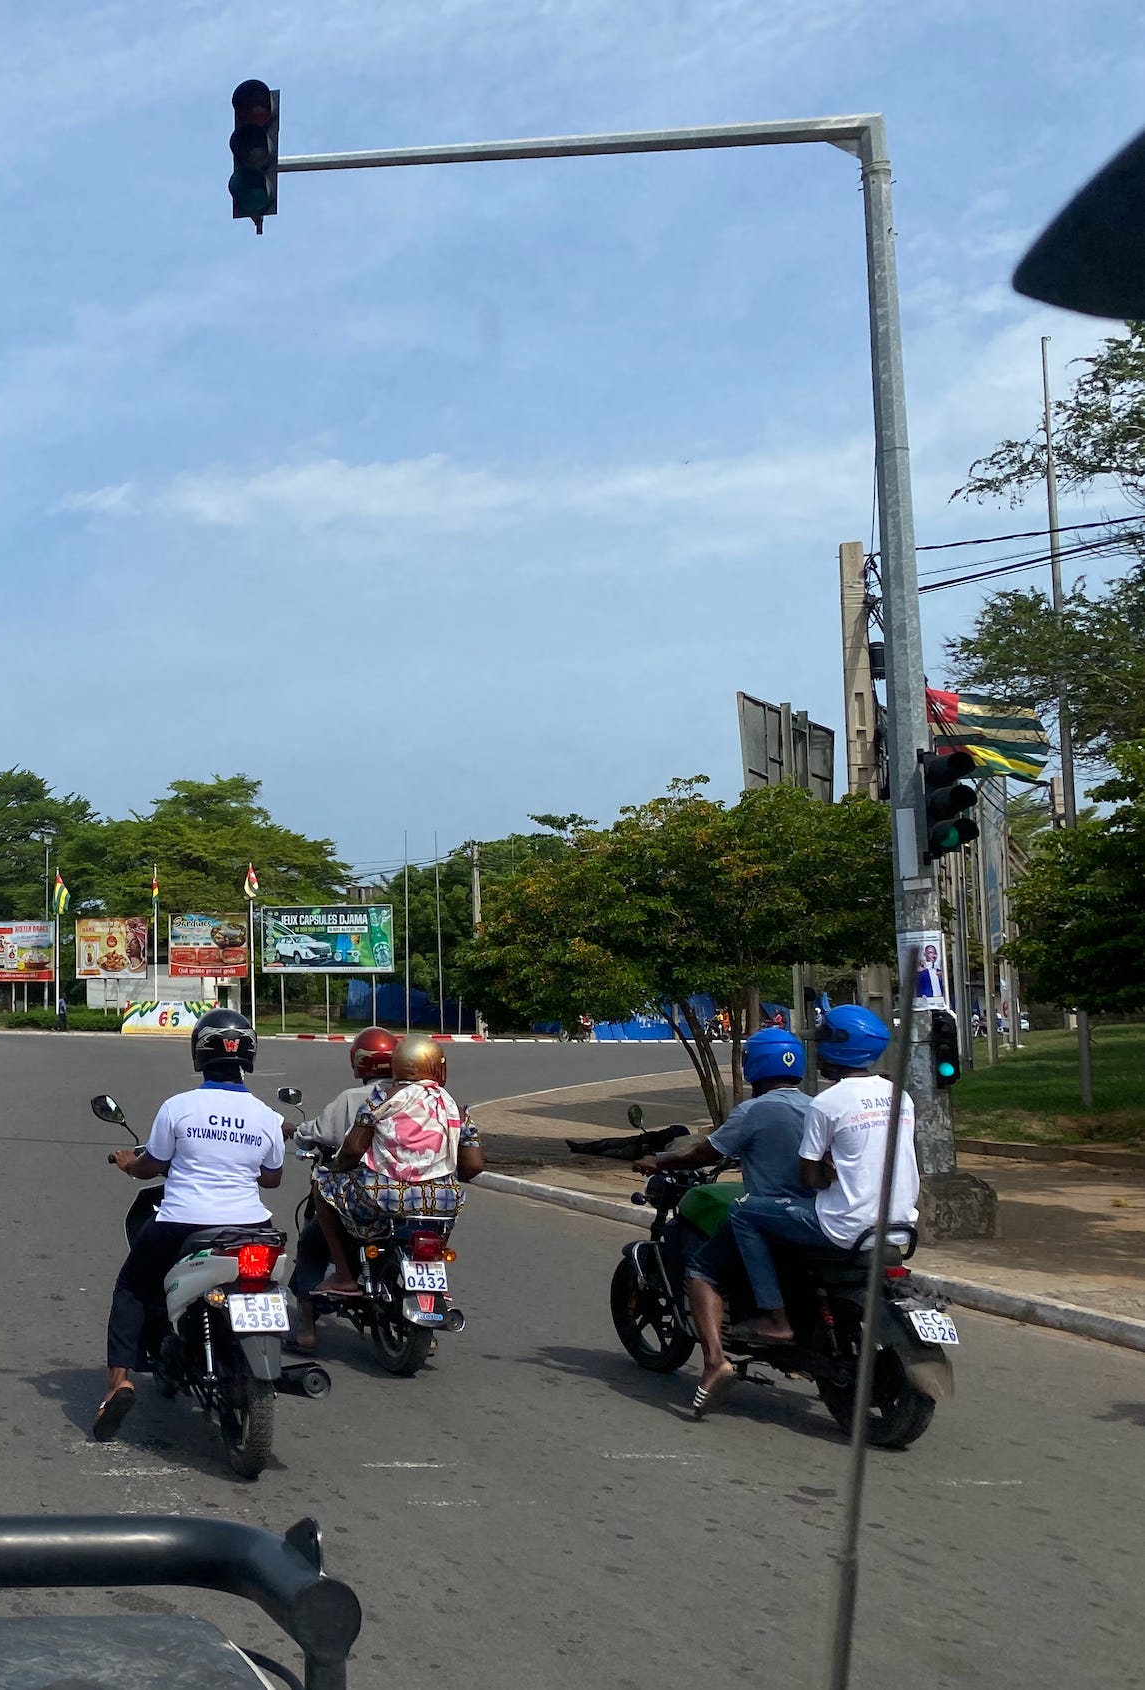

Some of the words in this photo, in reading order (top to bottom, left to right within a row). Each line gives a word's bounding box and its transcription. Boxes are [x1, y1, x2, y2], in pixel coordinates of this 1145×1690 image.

[279, 914, 299, 926] JEUX
[299, 913, 339, 926] CAPSULES
[339, 913, 369, 925] DJAMA
[861, 1098, 873, 1109] 50
[208, 1114, 245, 1129] CHU
[186, 1127, 228, 1141] SYLVANUS
[229, 1131, 262, 1147] OLYMPIO
[415, 1263, 435, 1276] DL
[407, 1276, 446, 1290] 0432
[244, 1297, 270, 1312] EJ
[234, 1312, 286, 1329] 4358
[919, 1312, 943, 1326] EC
[918, 1325, 957, 1342] 0326
